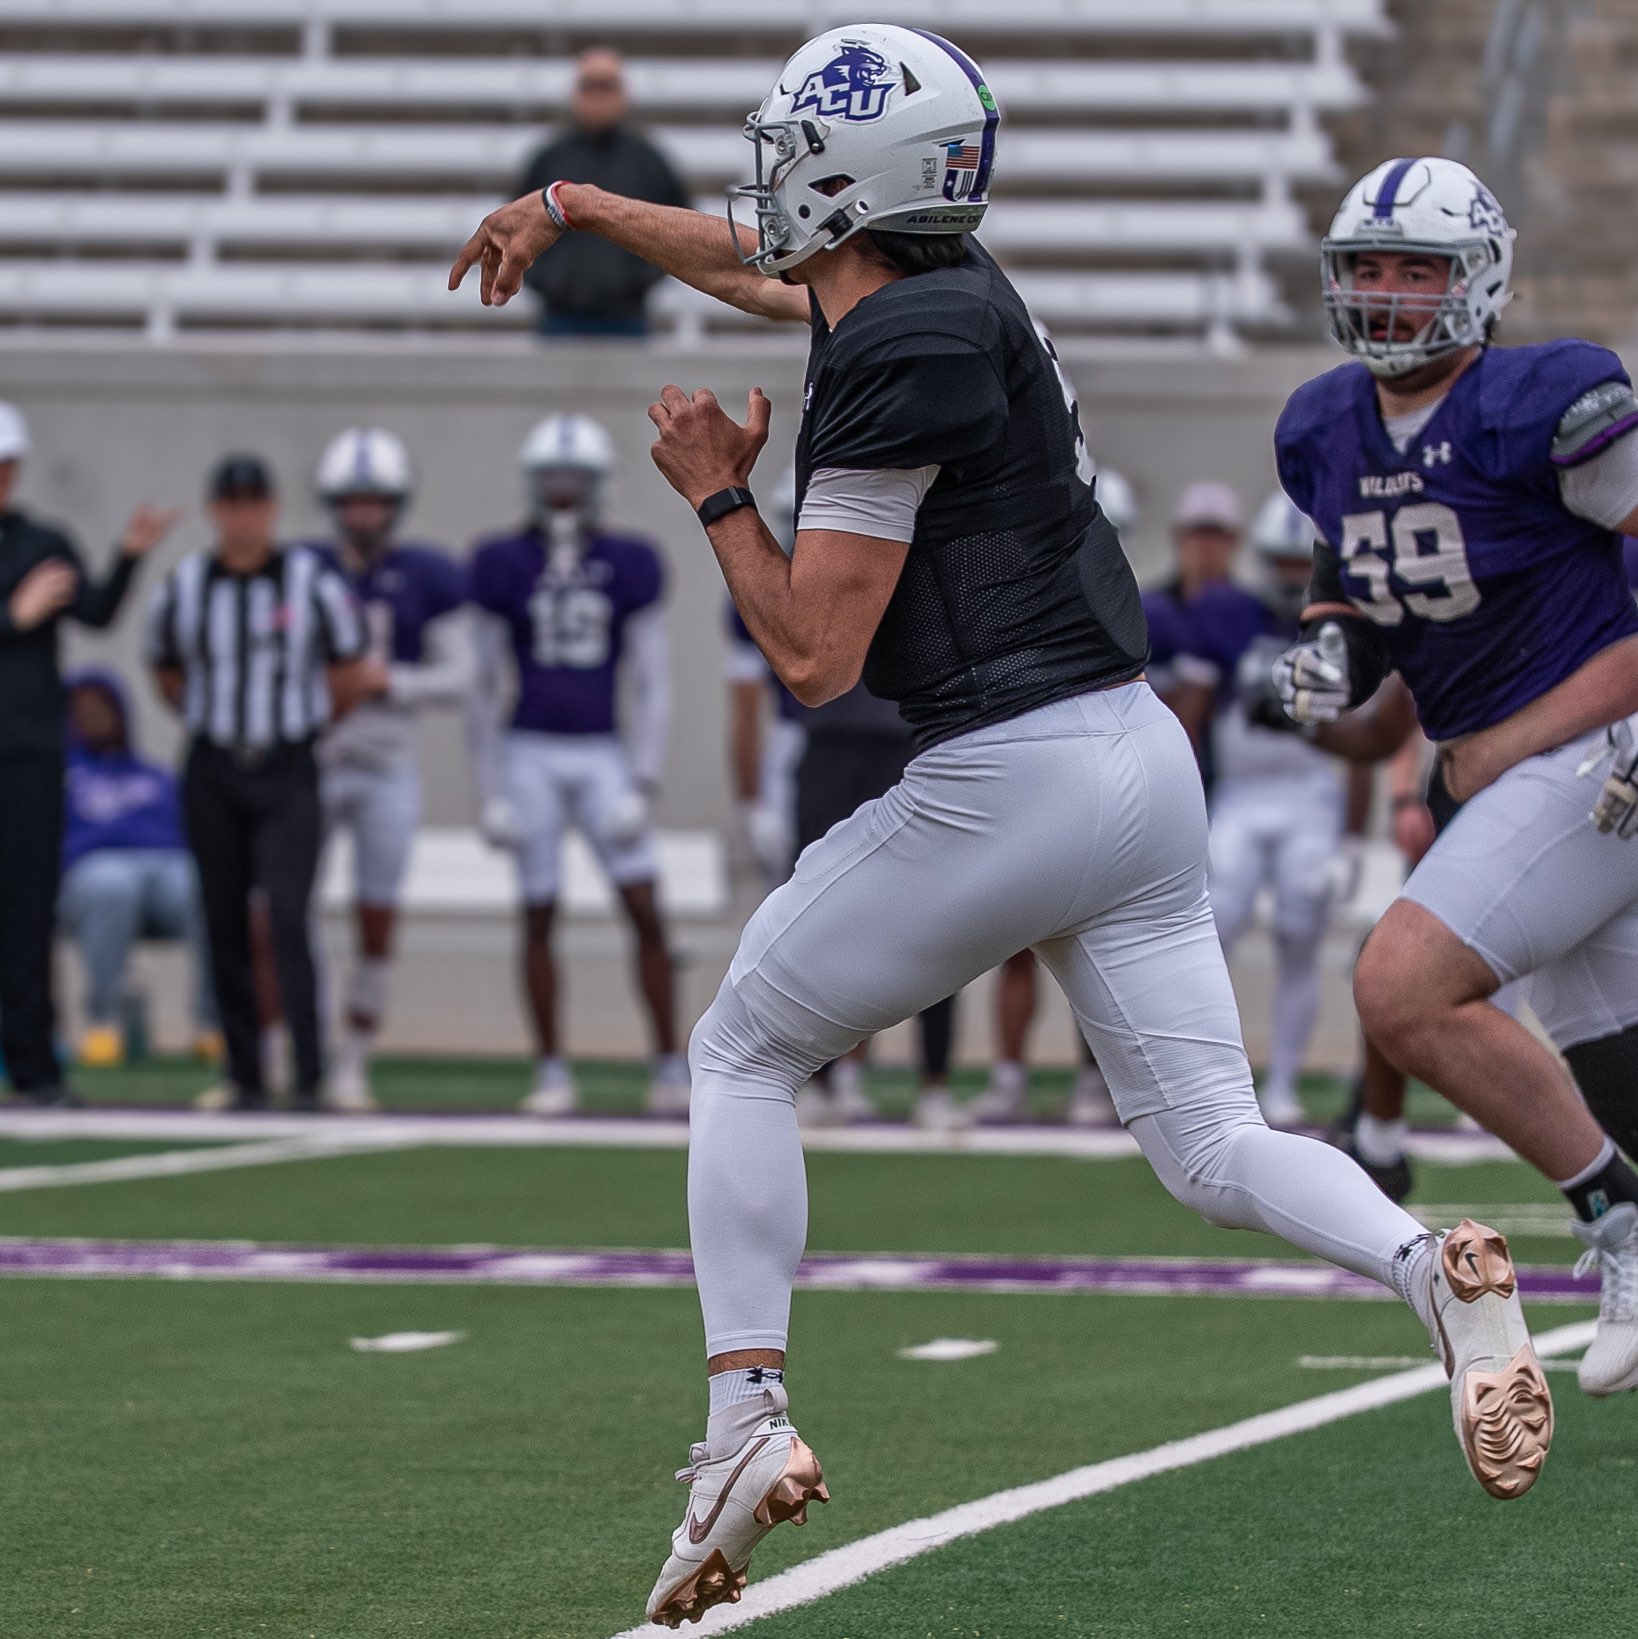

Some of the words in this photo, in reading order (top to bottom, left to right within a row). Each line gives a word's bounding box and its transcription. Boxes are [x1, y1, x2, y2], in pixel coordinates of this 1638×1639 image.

[793, 72, 893, 119] ACU
[907, 215, 966, 224] ABILENE
[1470, 199, 1506, 237] AC
[1341, 502, 1481, 626] 59
[769, 1417, 793, 1430] NIK
